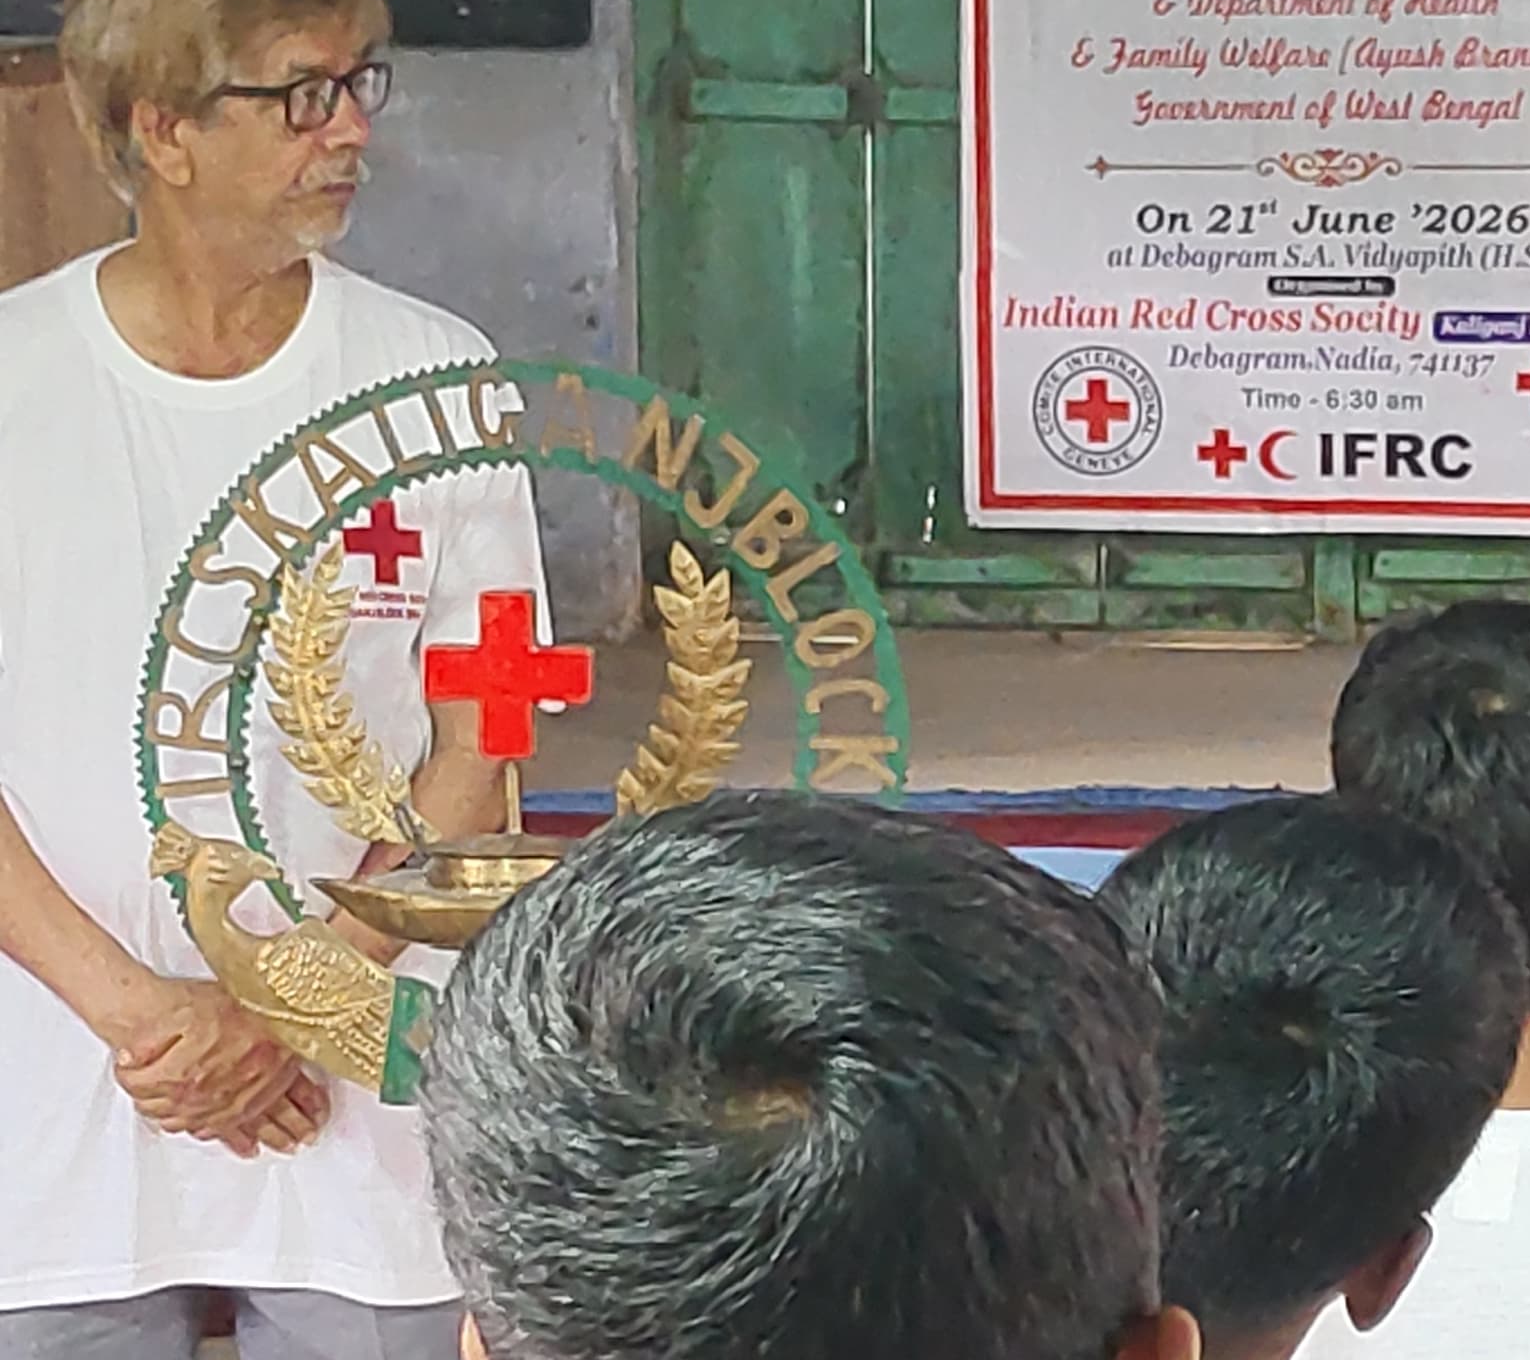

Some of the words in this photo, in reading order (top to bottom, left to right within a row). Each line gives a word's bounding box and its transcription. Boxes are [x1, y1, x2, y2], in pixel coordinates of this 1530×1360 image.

[1071, 37, 1095, 68] &
[1102, 37, 1210, 78] Family
[1219, 37, 1332, 77] Welfare
[1132, 90, 1296, 127] Government
[1303, 90, 1337, 129] of
[1344, 90, 1413, 120] West
[1421, 90, 1525, 129] Bengal
[1136, 203, 1193, 235] On
[1205, 198, 1279, 235] 21st
[1291, 203, 1396, 235] June
[1106, 243, 1134, 268] at
[1141, 242, 1278, 275] Debagram
[1283, 242, 1335, 269] S.A.
[1345, 241, 1474, 275] Vidyapith
[1003, 297, 1119, 330] Indian
[1130, 297, 1196, 331] Red
[1206, 299, 1302, 333] Cross
[1310, 298, 1422, 339] Socity
[1408, 353, 1496, 378] 741137
[1242, 387, 1302, 410] Time
[1386, 394, 1424, 410] am
[1320, 432, 1473, 479] IFRC
